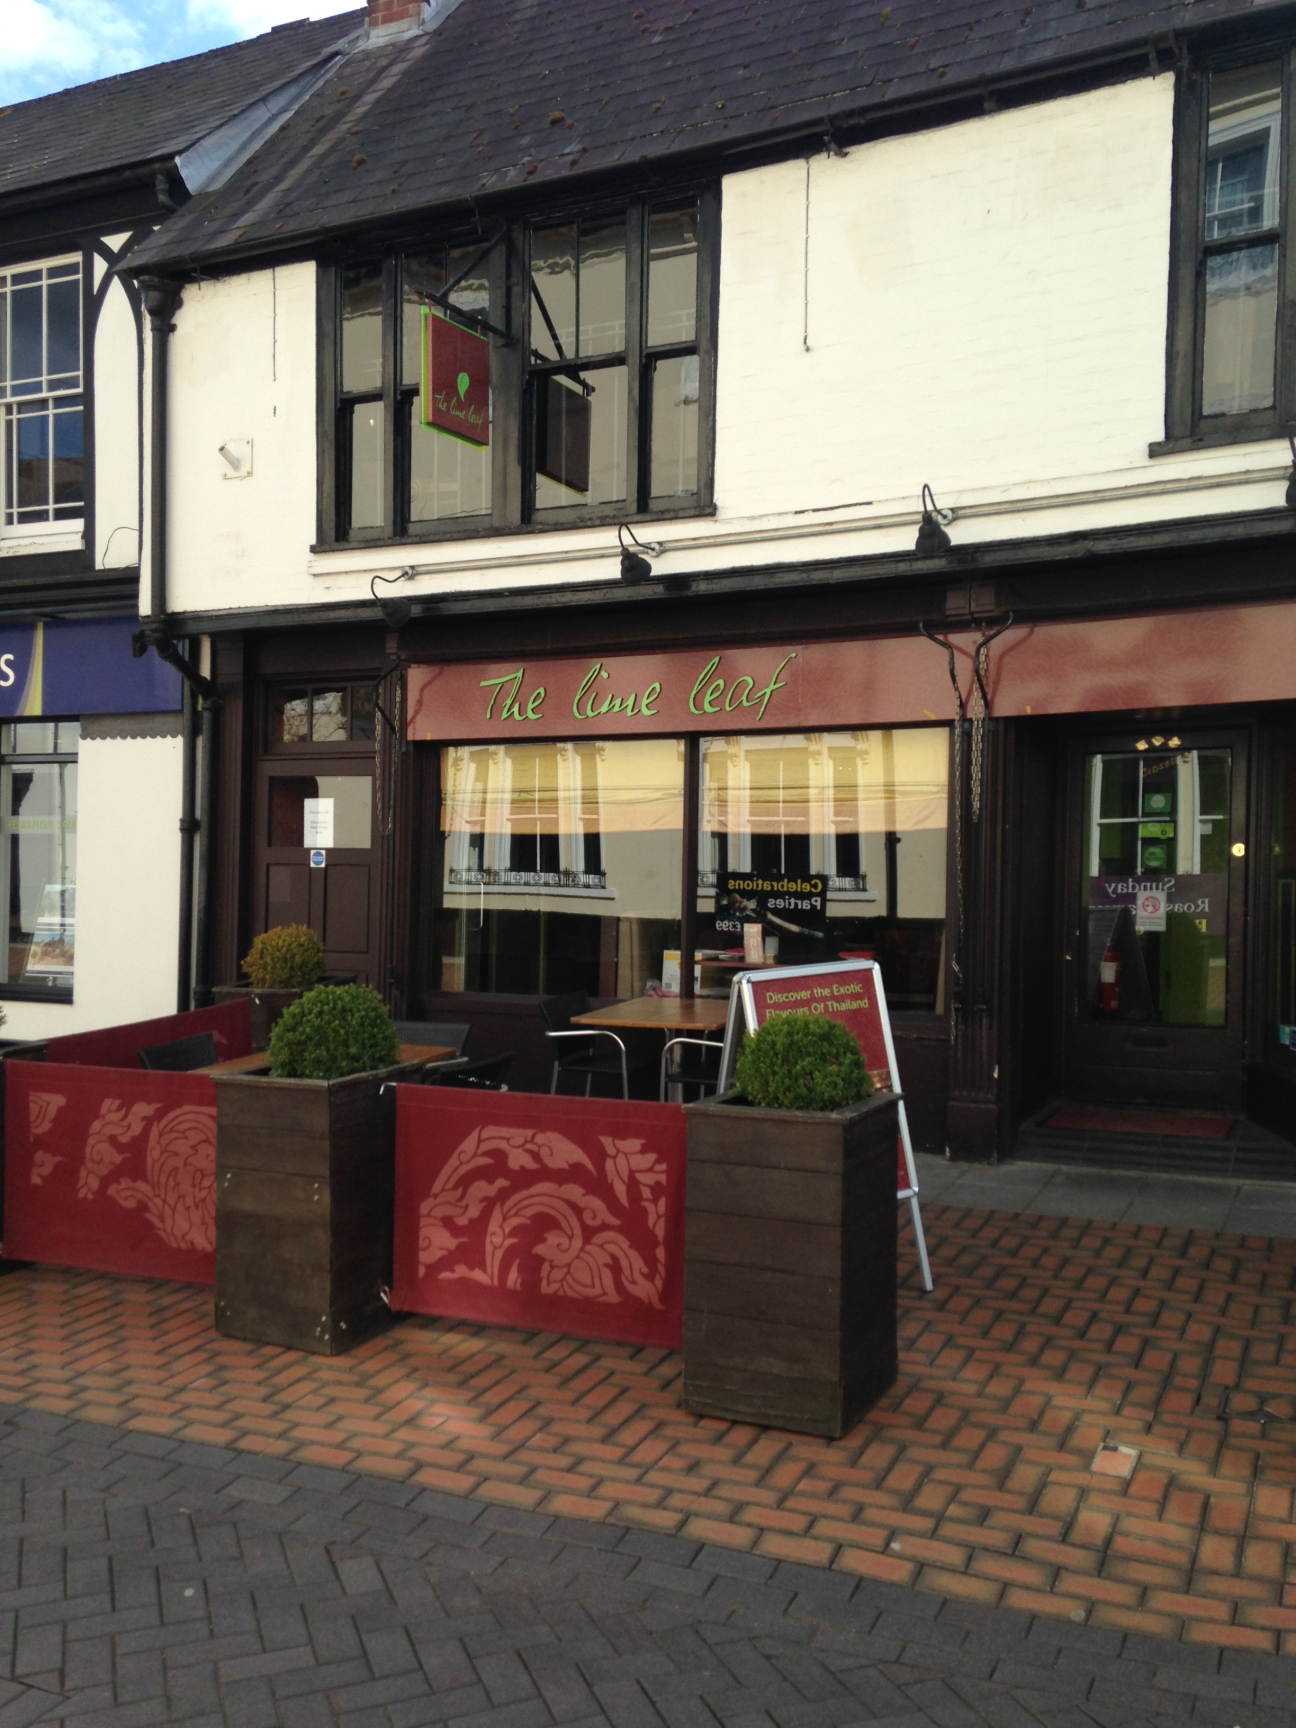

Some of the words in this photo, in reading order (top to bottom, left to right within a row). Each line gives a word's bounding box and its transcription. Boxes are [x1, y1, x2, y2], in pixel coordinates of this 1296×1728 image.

[435, 391, 447, 412] The
[450, 397, 465, 419] lime
[468, 405, 486, 432] leaf
[480, 667, 546, 721] The
[572, 662, 662, 720] lime
[688, 652, 797, 722] leaf
[766, 990, 812, 1004] Discover
[813, 986, 831, 998] the
[832, 982, 864, 996] Exotic
[811, 1002, 825, 1014] Of
[826, 997, 869, 1012] Thailand
